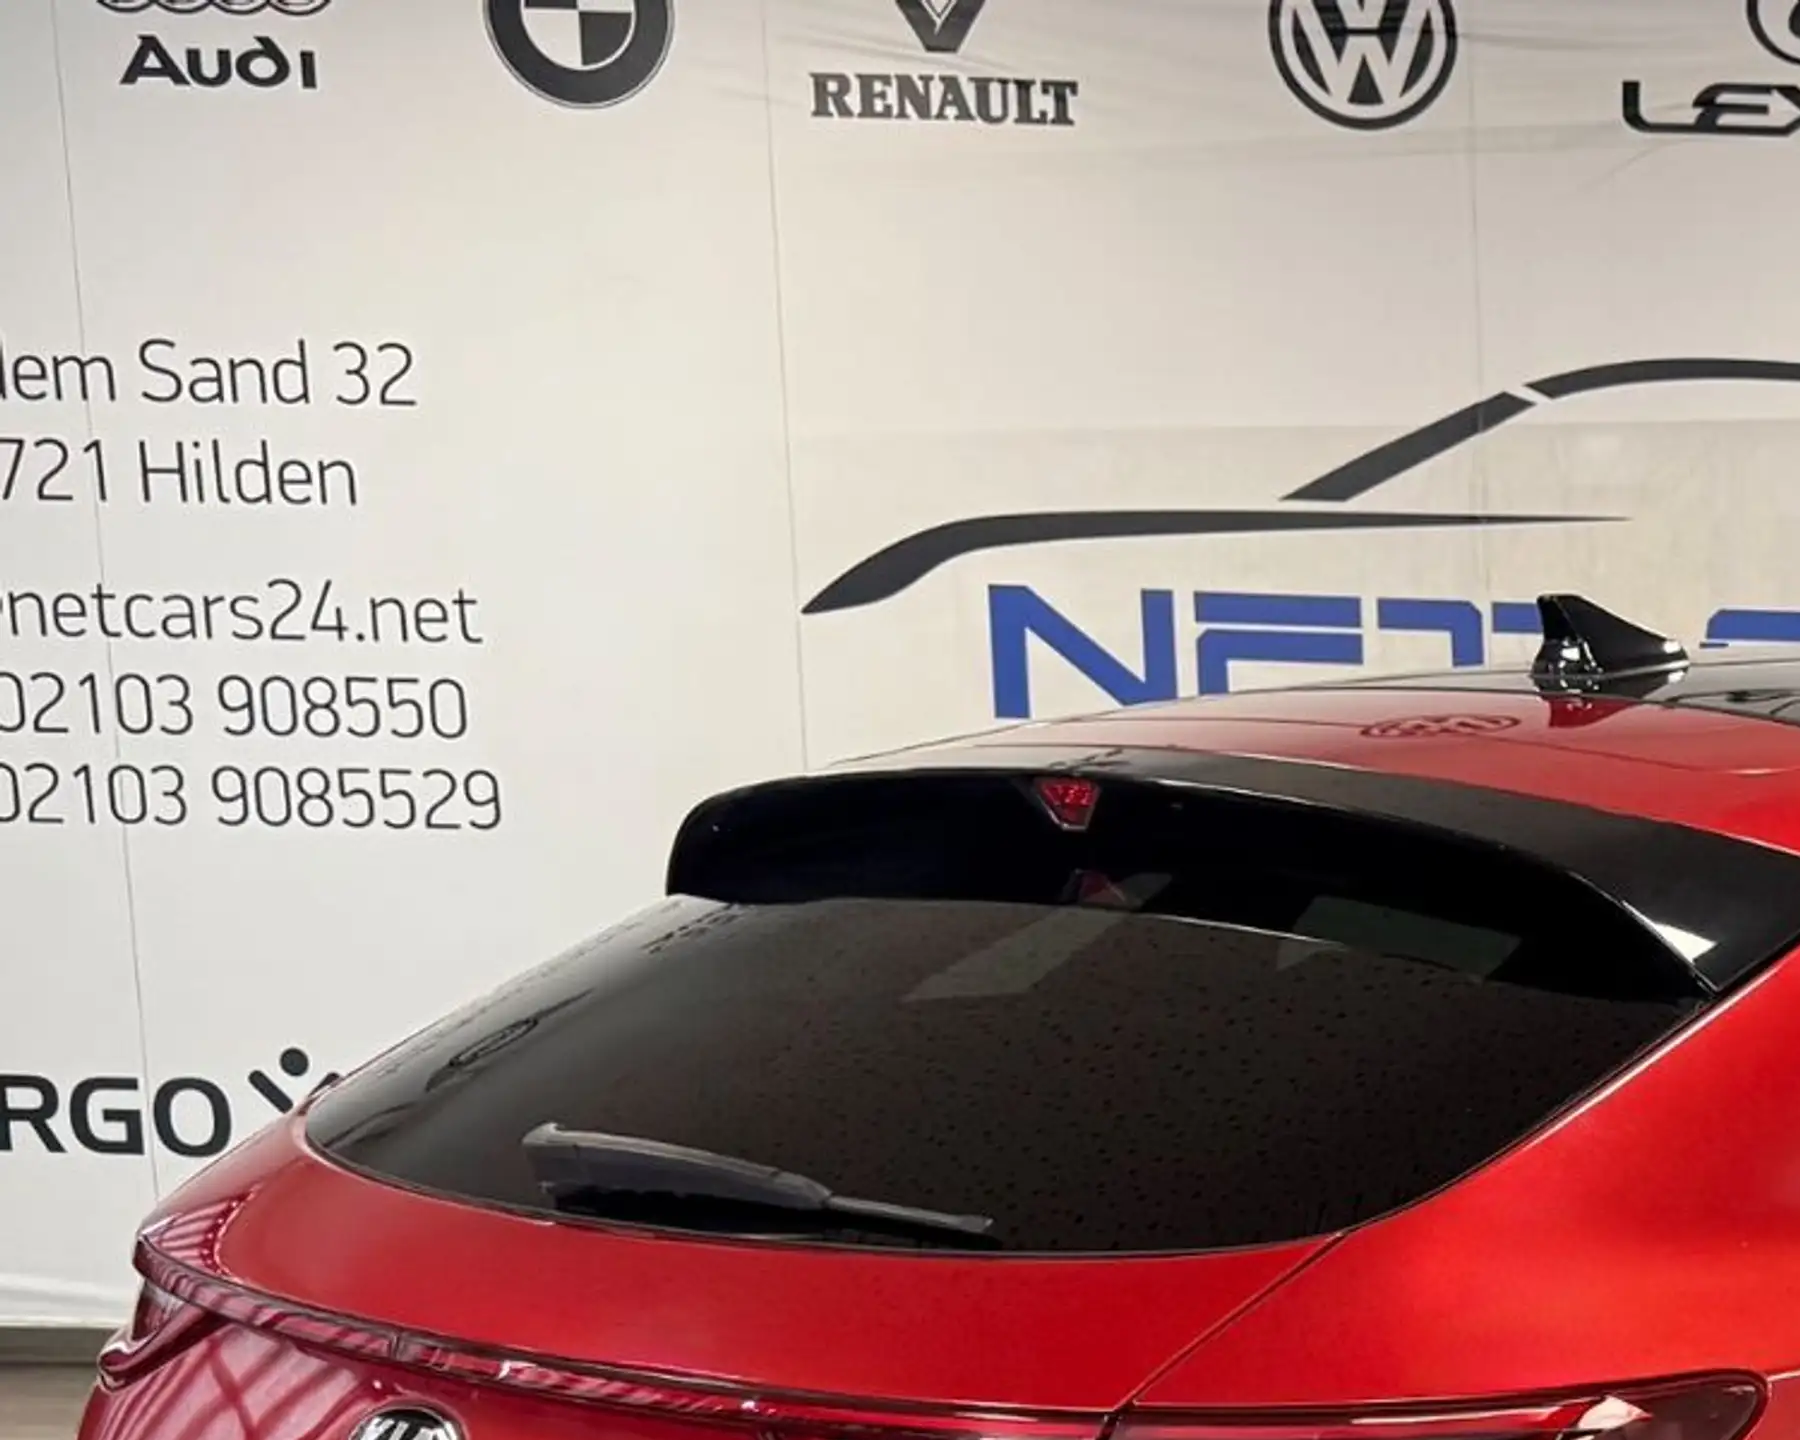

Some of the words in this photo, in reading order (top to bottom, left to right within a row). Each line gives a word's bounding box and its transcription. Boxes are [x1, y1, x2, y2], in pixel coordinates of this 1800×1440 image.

[120, 35, 317, 89] Audi
[811, 73, 1078, 126] RENAULT
[140, 339, 309, 404] Sand
[334, 342, 415, 405] 32
[0, 438, 106, 501] 721
[140, 439, 356, 504] Hilden
[0, 579, 482, 643] netcars24.net
[0, 672, 192, 735] 02103
[218, 675, 467, 738] 908550
[0, 763, 186, 825] 02103
[212, 766, 501, 830] 9085529
[0, 1074, 232, 1158] RGO
